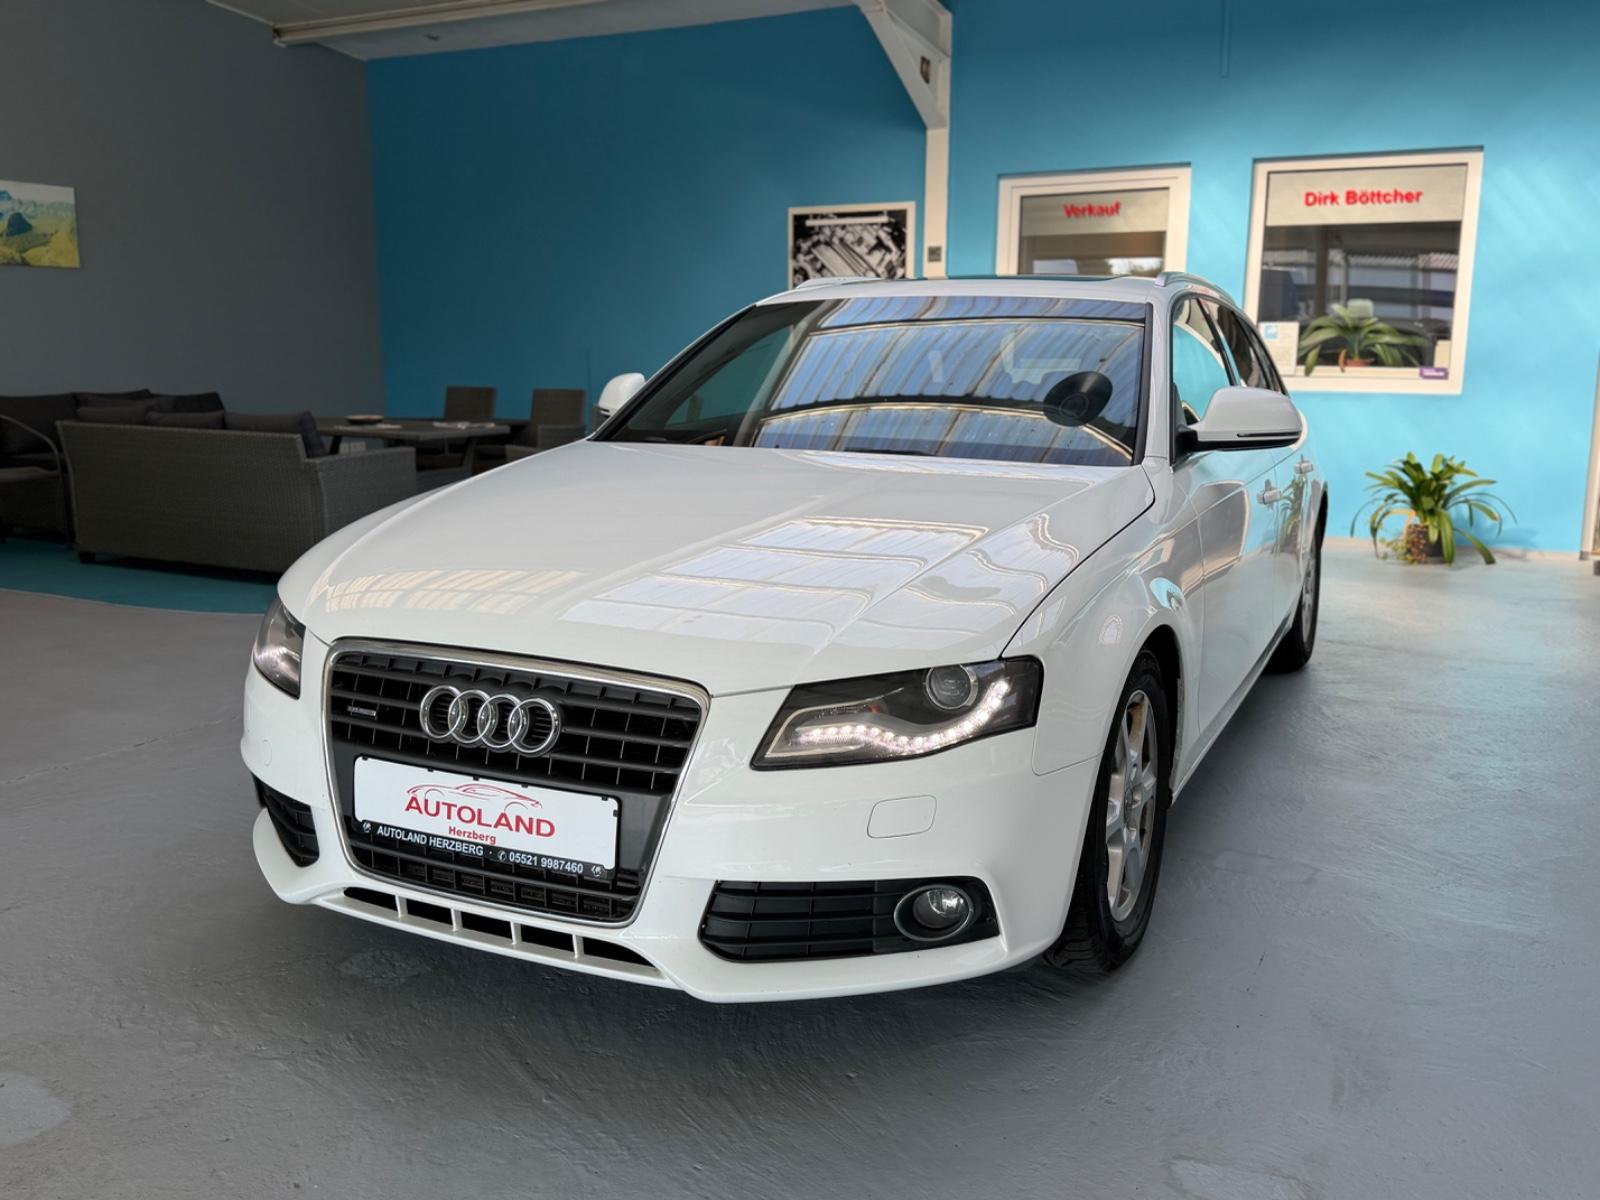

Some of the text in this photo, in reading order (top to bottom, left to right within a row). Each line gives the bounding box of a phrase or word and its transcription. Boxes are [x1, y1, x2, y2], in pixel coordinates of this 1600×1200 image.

[1304, 188, 1423, 208] Dirk Böttcher
[1063, 201, 1121, 219] Verkauf
[405, 796, 557, 838] AUTOLAND
[448, 825, 497, 845] Herzberg
[376, 826, 584, 875] AUTOLAND HERZBERG 05521 9987460
